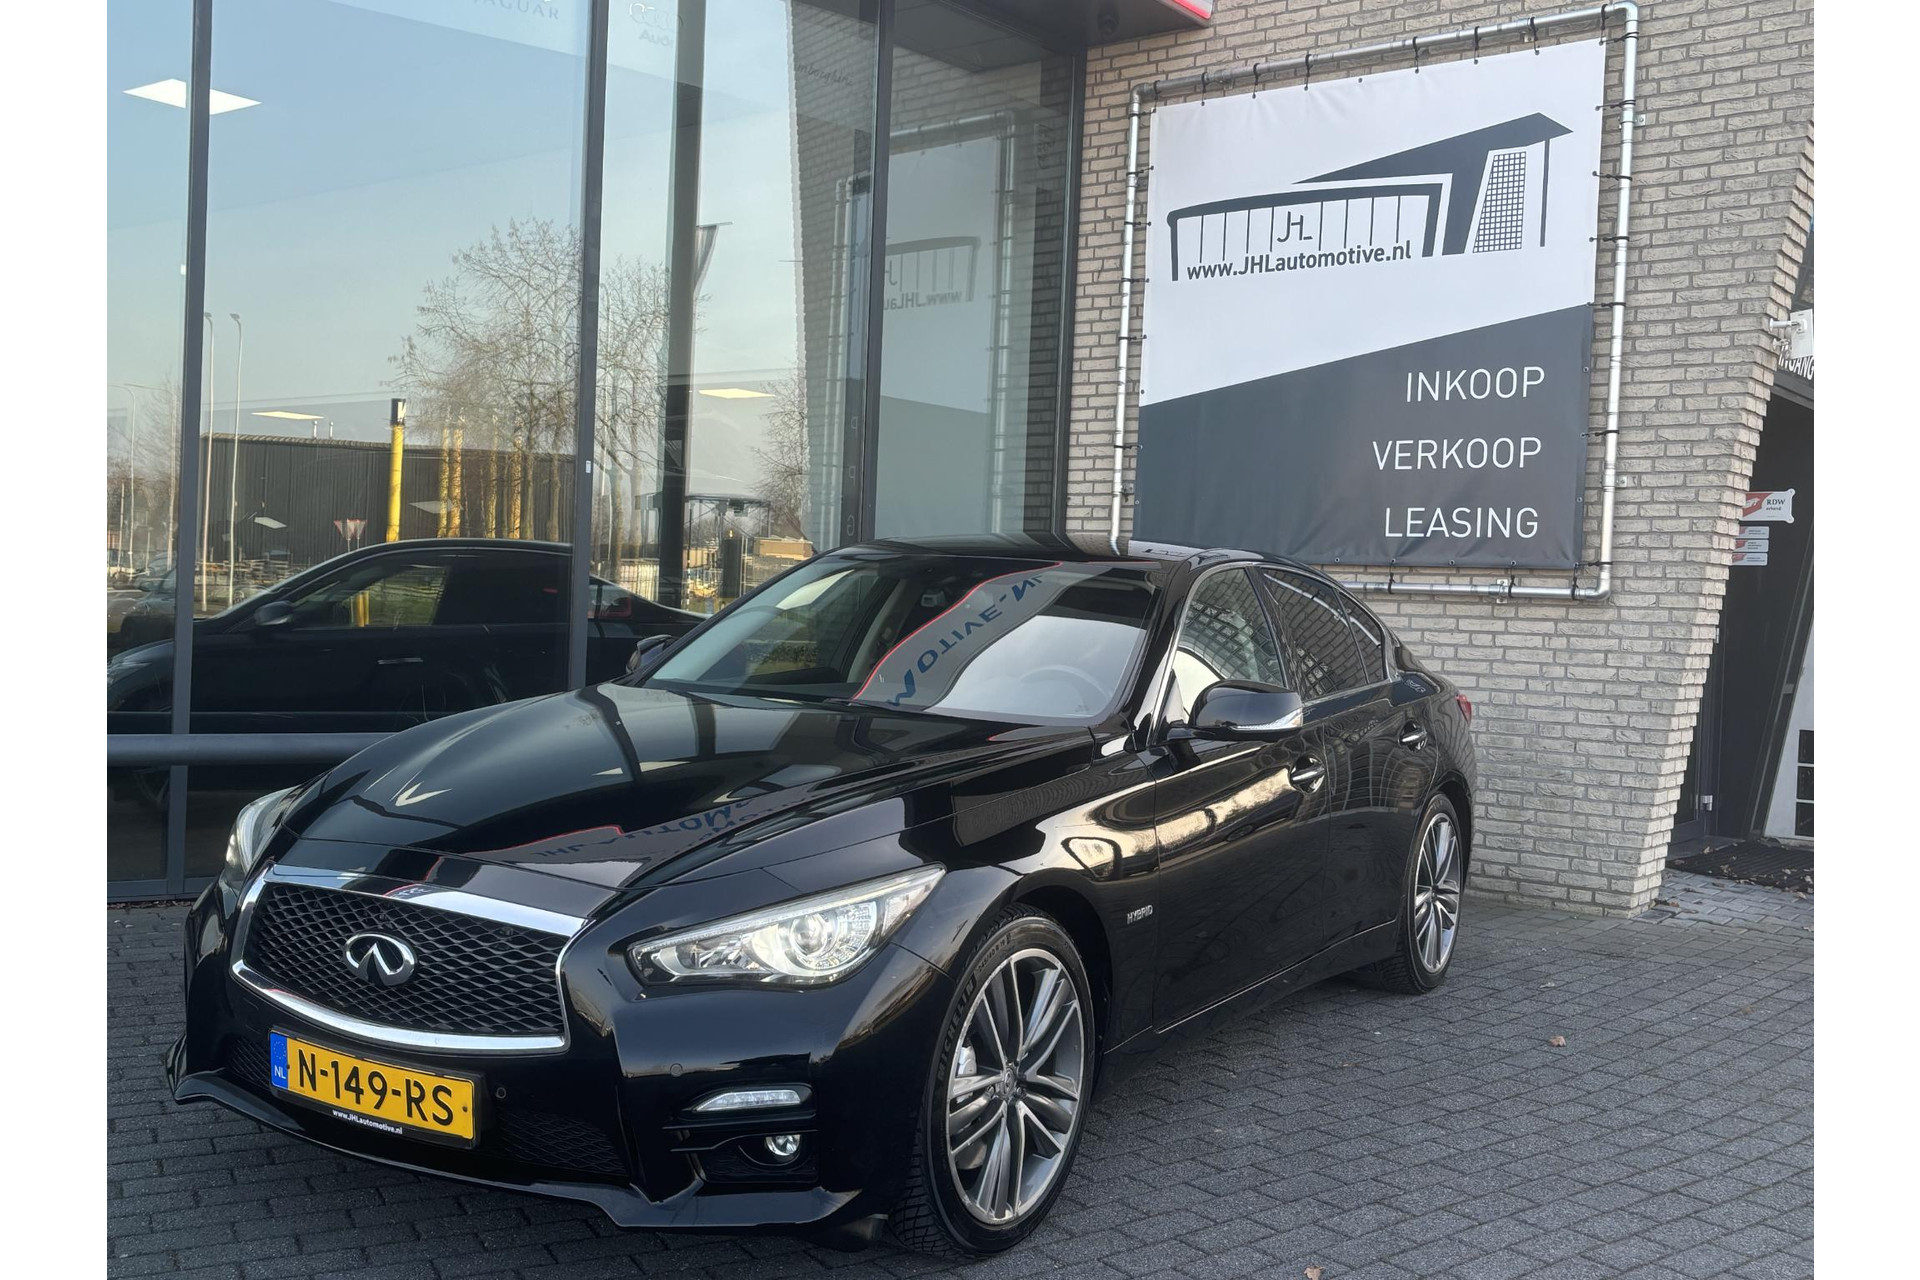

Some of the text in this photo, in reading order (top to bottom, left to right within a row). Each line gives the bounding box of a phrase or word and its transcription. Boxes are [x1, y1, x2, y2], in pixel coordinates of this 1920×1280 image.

[1276, 210, 1313, 243] JHL
[1187, 240, 1412, 280] www.JHLautomotive.nl
[1406, 366, 1545, 402] INKOOP
[1372, 436, 1542, 470] VERKOOP
[1766, 498, 1786, 506] RDW
[1385, 507, 1539, 538] LEASING
[1126, 904, 1153, 925] HYBRID
[937, 977, 975, 1081] MICHELIN
[274, 1064, 287, 1080] NL
[298, 1048, 454, 1126] N-149-RS
[332, 1108, 403, 1135] www.JHLautomotive.nl
